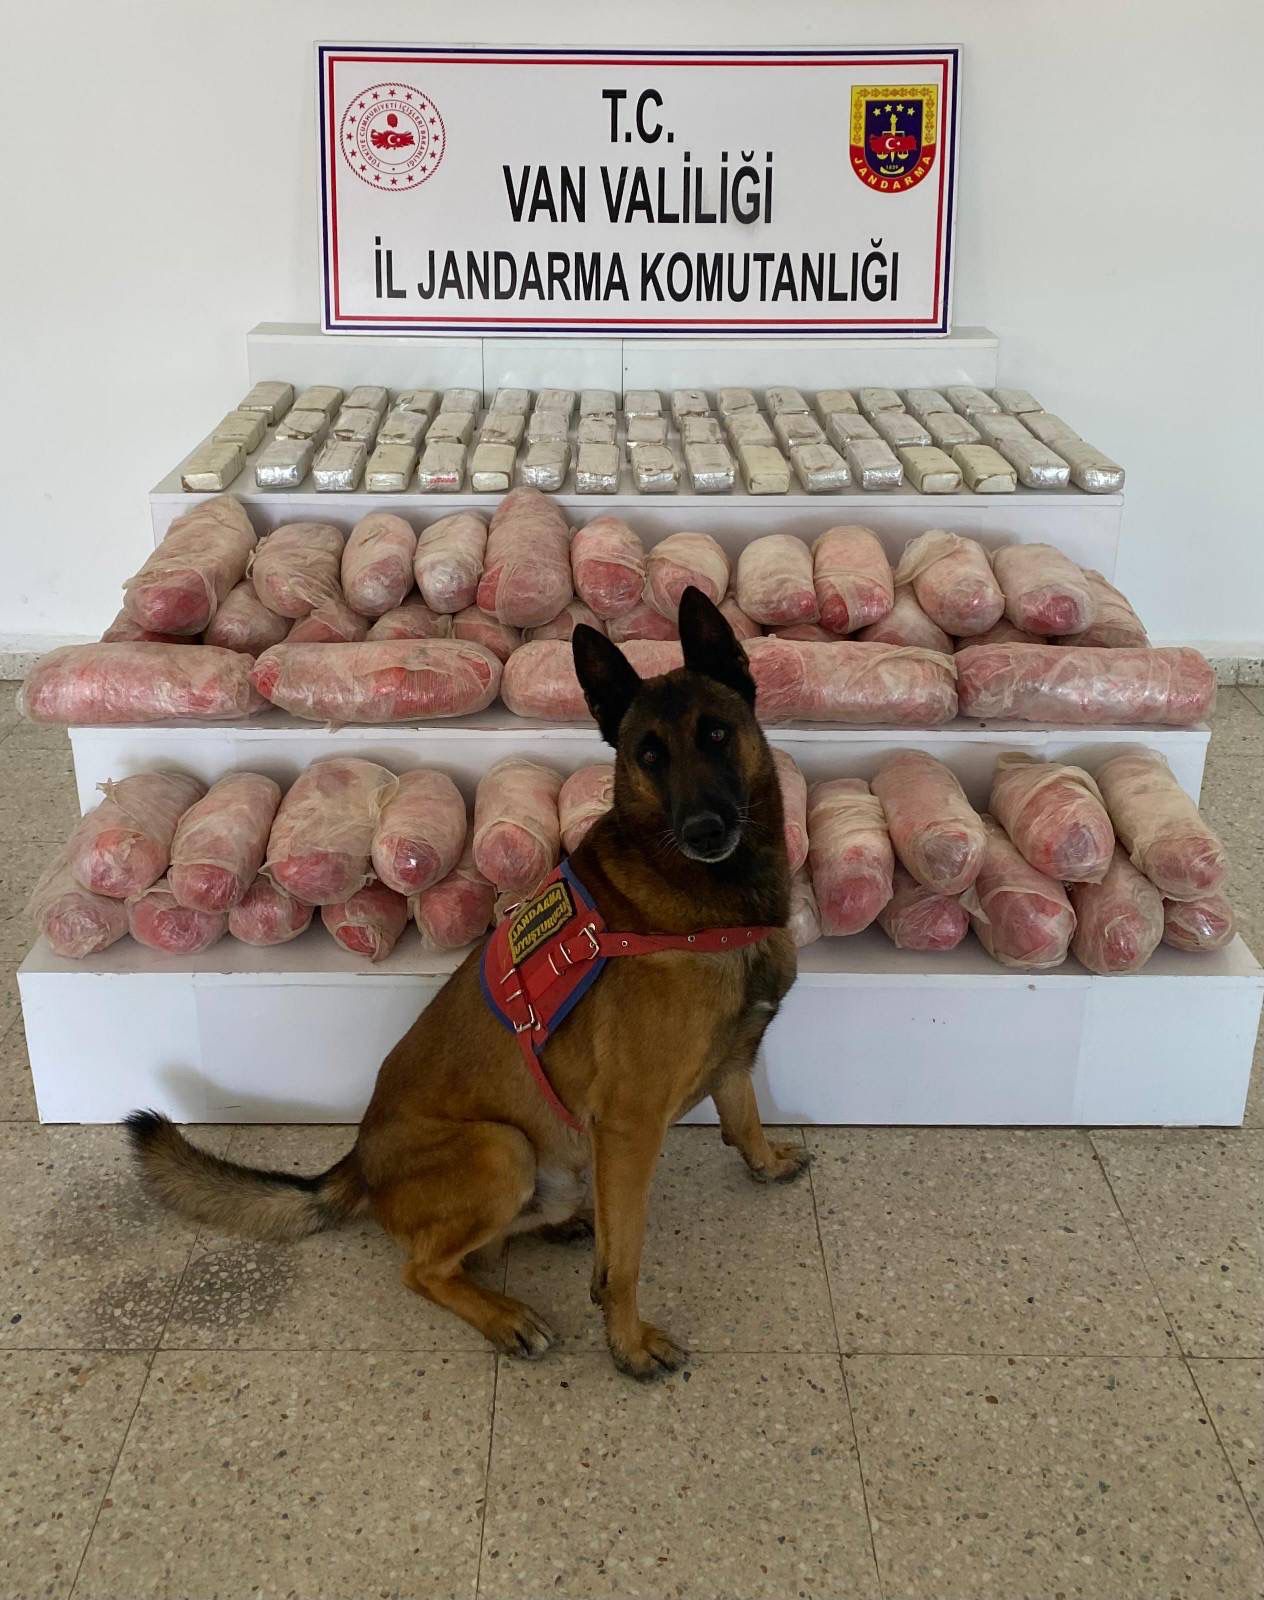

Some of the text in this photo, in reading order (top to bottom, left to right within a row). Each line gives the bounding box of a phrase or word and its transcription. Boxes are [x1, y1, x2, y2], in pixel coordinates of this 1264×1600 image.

[360, 102, 397, 137] CUMHURİYETİ
[406, 130, 425, 168] BAKANLIĞI
[602, 88, 674, 144] T.C.
[502, 150, 773, 224] VAN VALİLİĞİ
[854, 156, 931, 190] JANDARMA
[375, 235, 899, 303] İL JANDARMA KOMUTANLIĞI
[512, 888, 562, 943] JANDARMA
